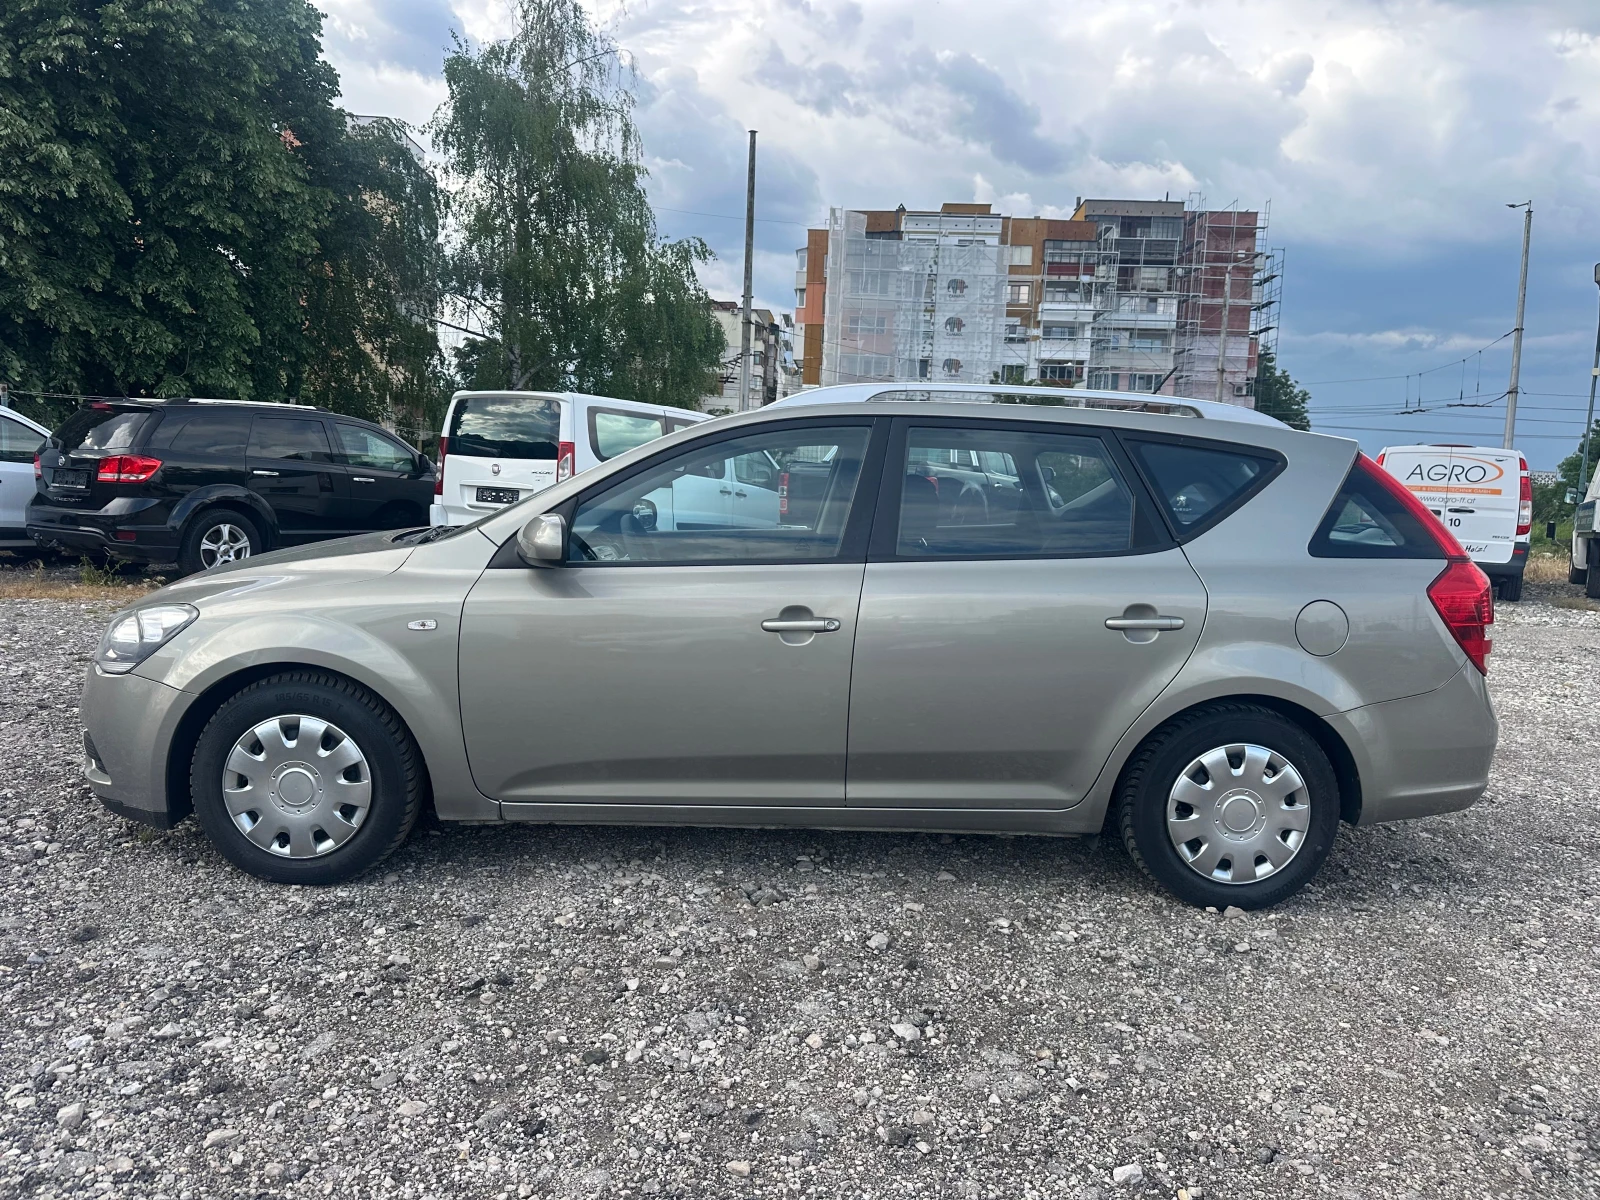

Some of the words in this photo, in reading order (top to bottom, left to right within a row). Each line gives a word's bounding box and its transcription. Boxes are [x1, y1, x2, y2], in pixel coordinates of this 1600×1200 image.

[1405, 463, 1487, 483] AGRO
[1448, 518, 1461, 527] 10
[274, 691, 310, 702] 185/65
[313, 694, 320, 704] R
[322, 696, 332, 707] 15
[336, 702, 344, 712] T
